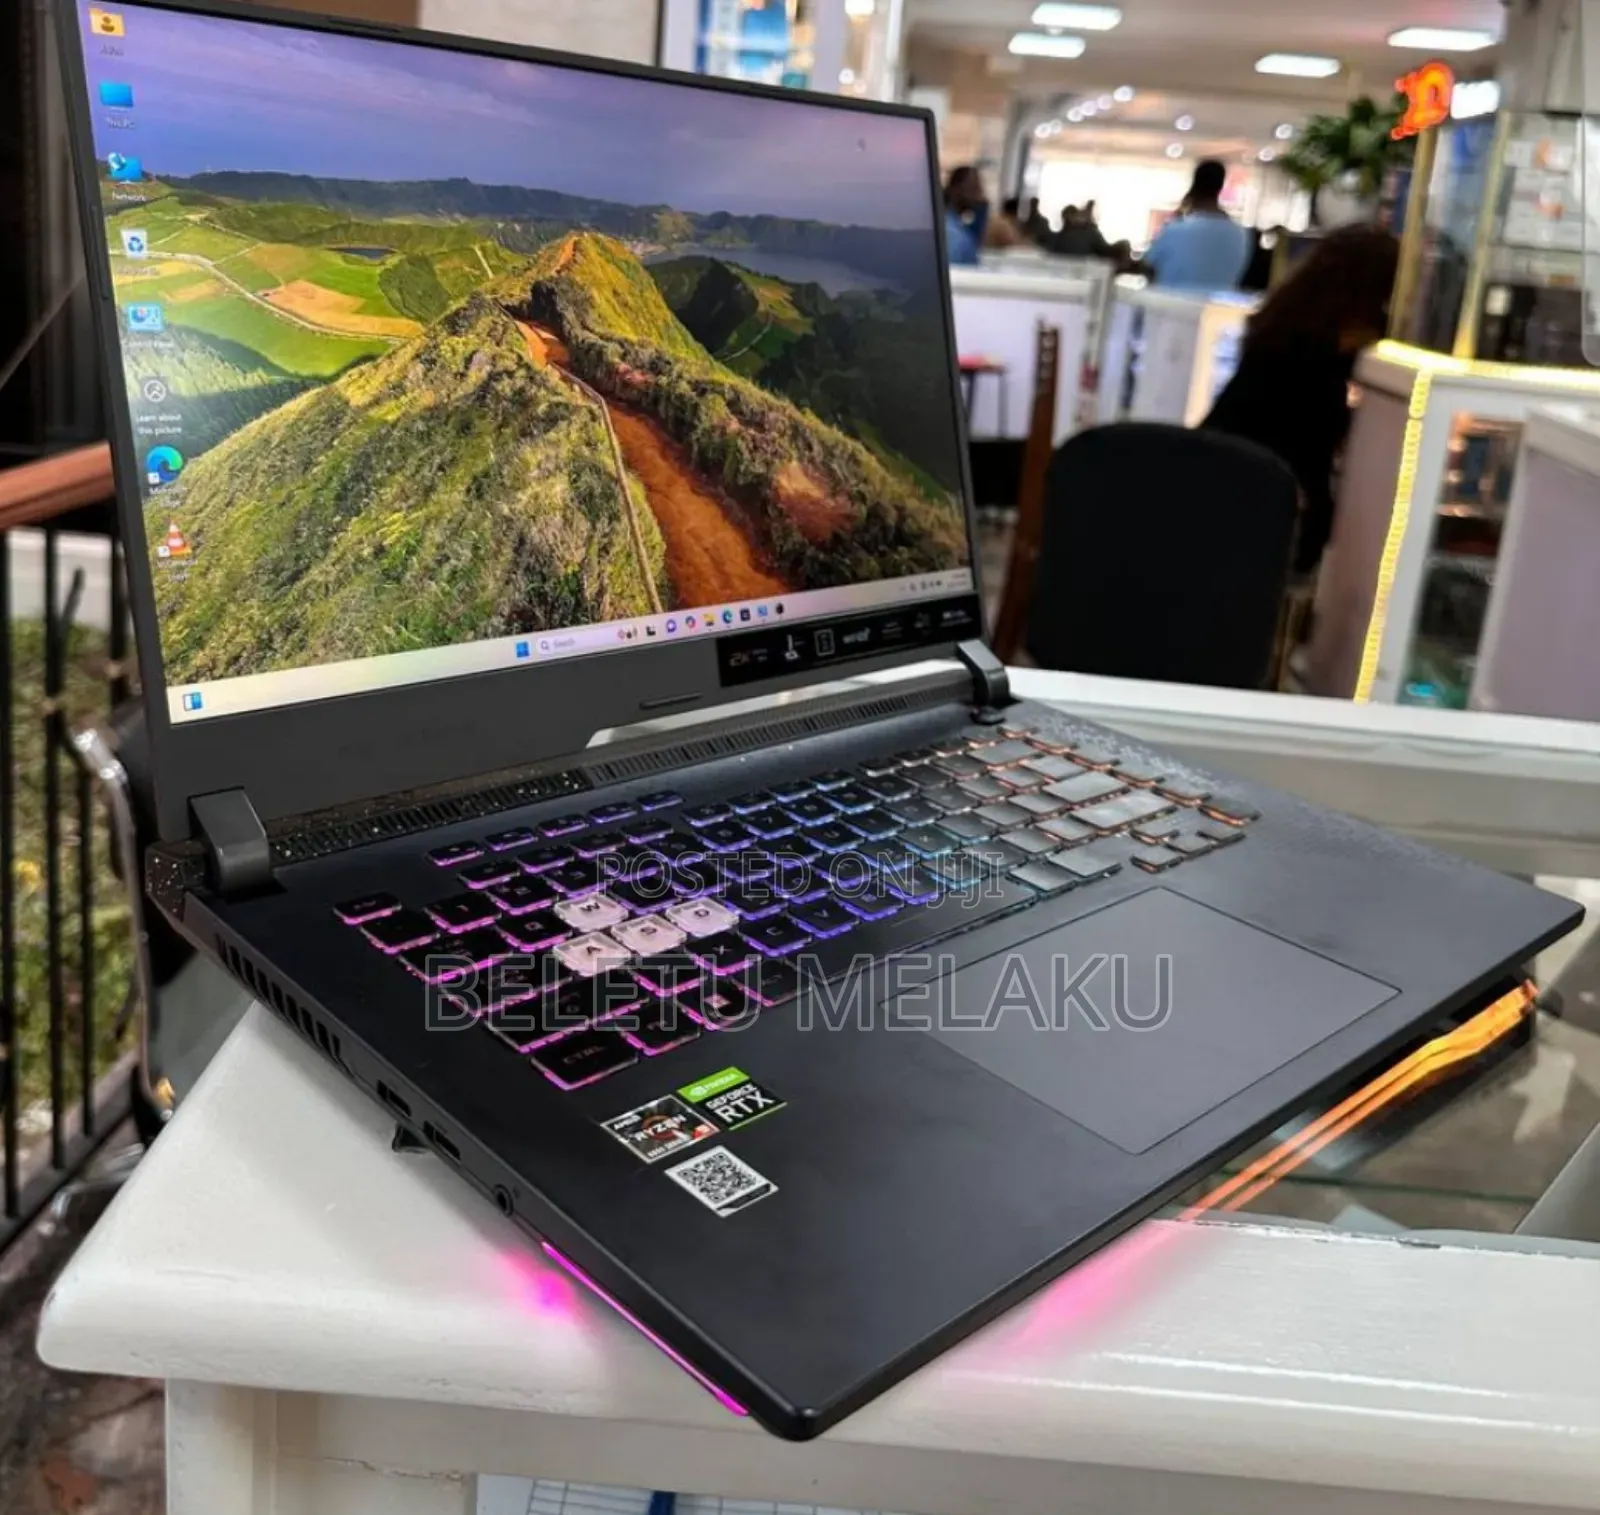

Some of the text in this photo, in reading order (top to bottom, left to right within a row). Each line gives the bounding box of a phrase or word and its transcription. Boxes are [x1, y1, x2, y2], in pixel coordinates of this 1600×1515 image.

[579, 901, 601, 913] W
[704, 1084, 757, 1109] GEFORCE
[714, 1089, 775, 1123] RTX
[633, 1113, 688, 1142] RYZEN
